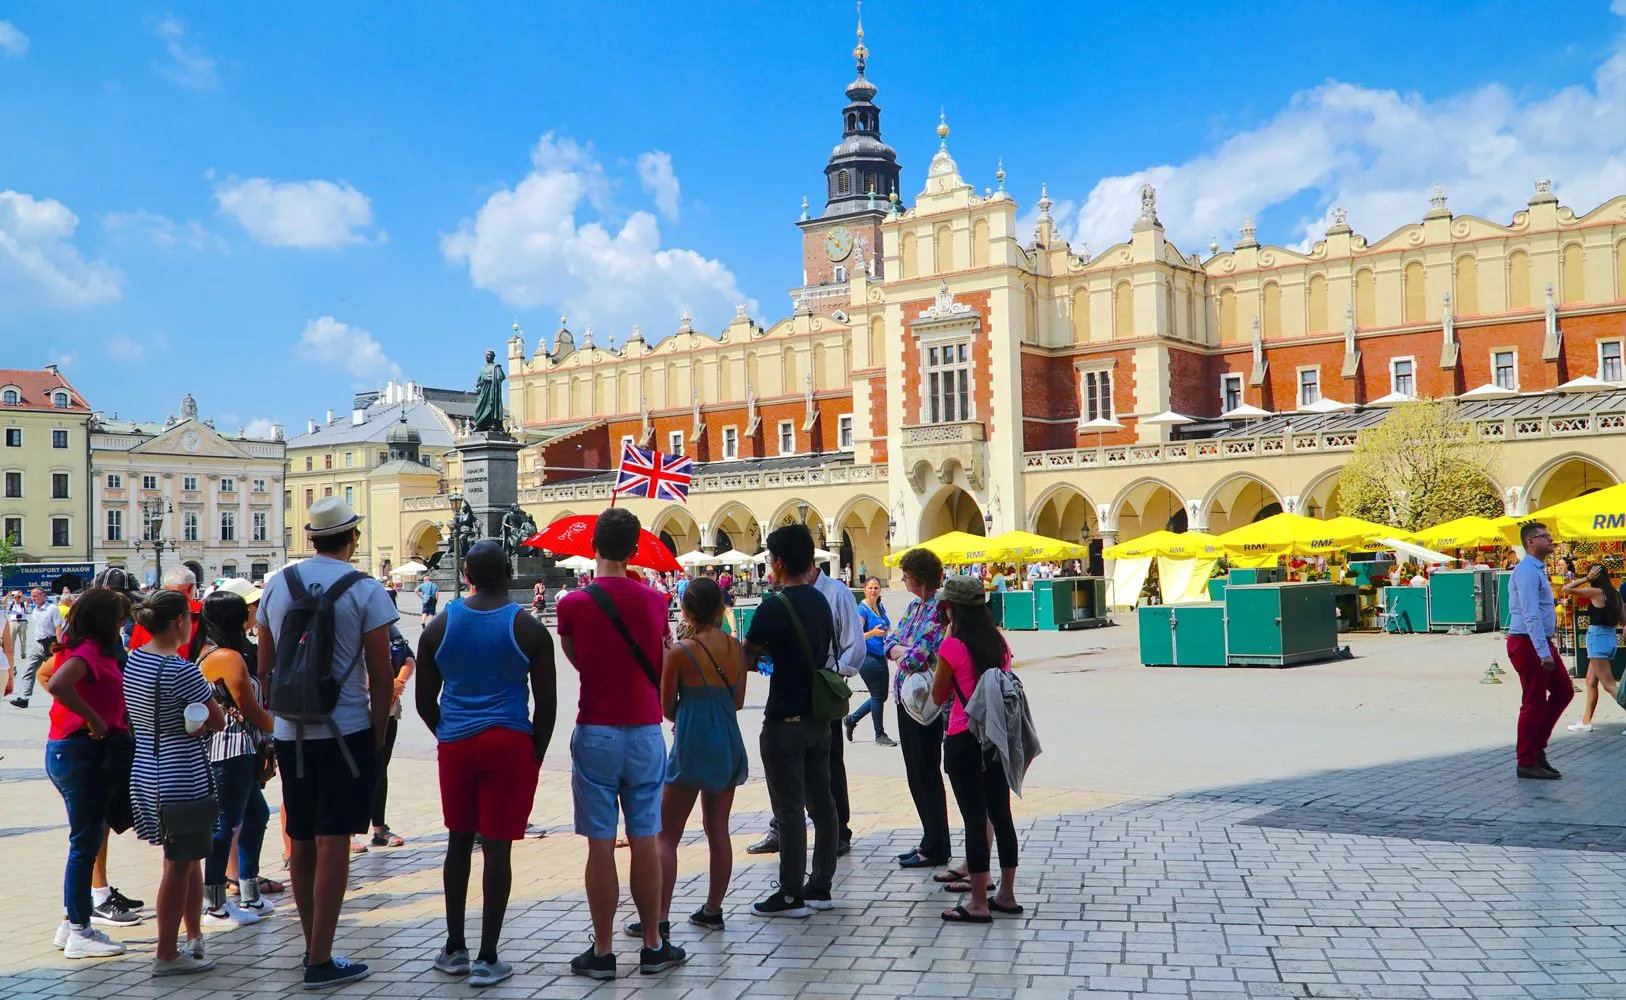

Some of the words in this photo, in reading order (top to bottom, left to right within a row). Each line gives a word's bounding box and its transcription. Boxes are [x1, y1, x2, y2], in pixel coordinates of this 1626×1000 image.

[1593, 513, 1626, 530] RM
[1243, 543, 1268, 551] RMF
[1310, 538, 1334, 549] RMF
[966, 551, 986, 560] RMF
